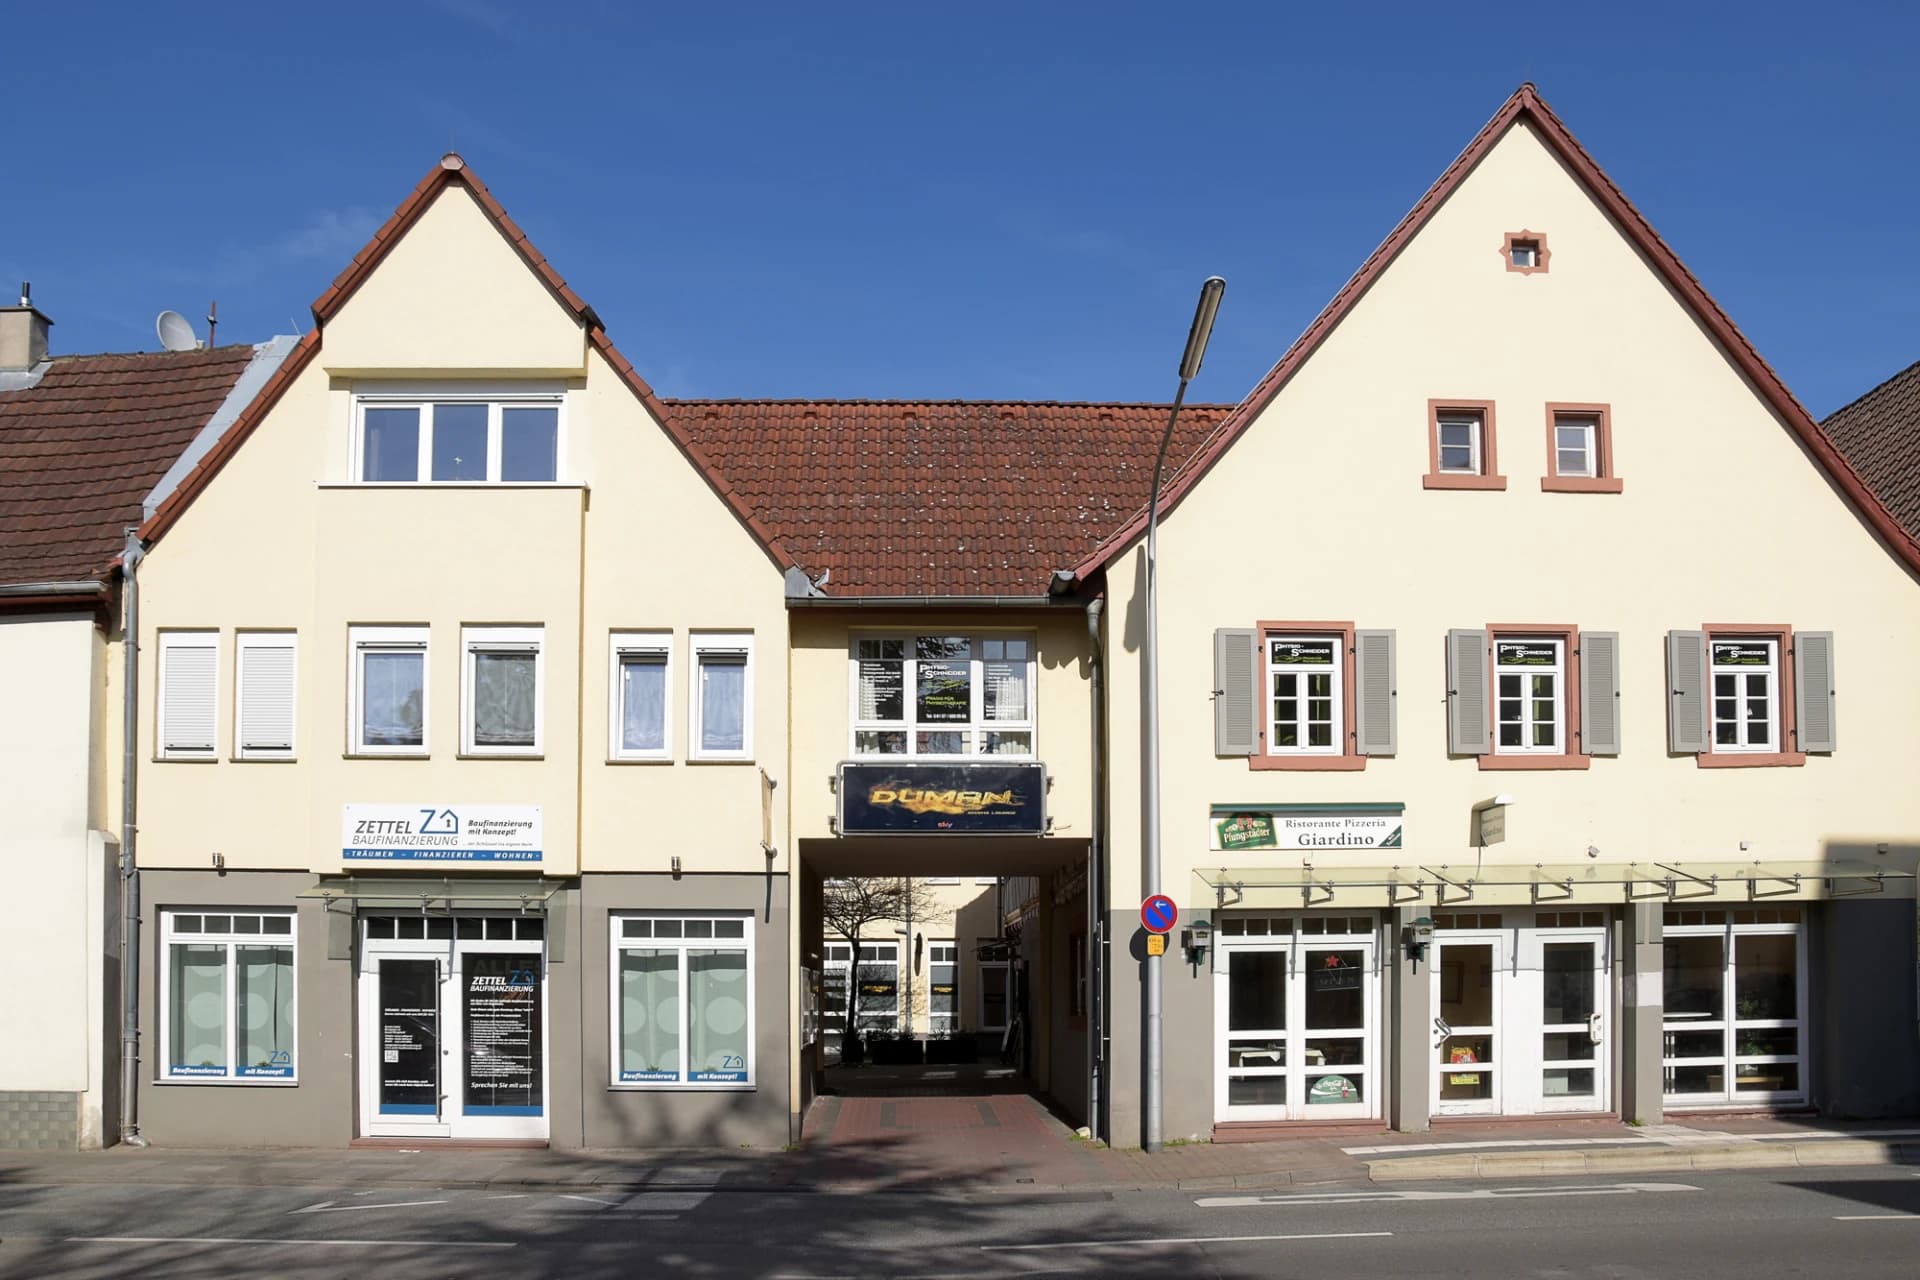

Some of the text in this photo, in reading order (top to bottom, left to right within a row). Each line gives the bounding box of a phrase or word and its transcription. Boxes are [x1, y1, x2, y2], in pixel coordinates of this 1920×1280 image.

[355, 820, 413, 834] ZETTEL
[468, 820, 533, 829] Baufinanzierung
[1285, 819, 1386, 828] Ristorante Pizzeria
[468, 828, 517, 836] mit Konzept!
[352, 835, 458, 846] BAUFINANZIERUNG
[1298, 833, 1375, 846] Giardino
[352, 850, 534, 860] TRÄUMEN FINANZIEREN WOHNEN
[472, 976, 507, 985] ZETTEL
[470, 985, 534, 993] BAUFINANZIERUNG
